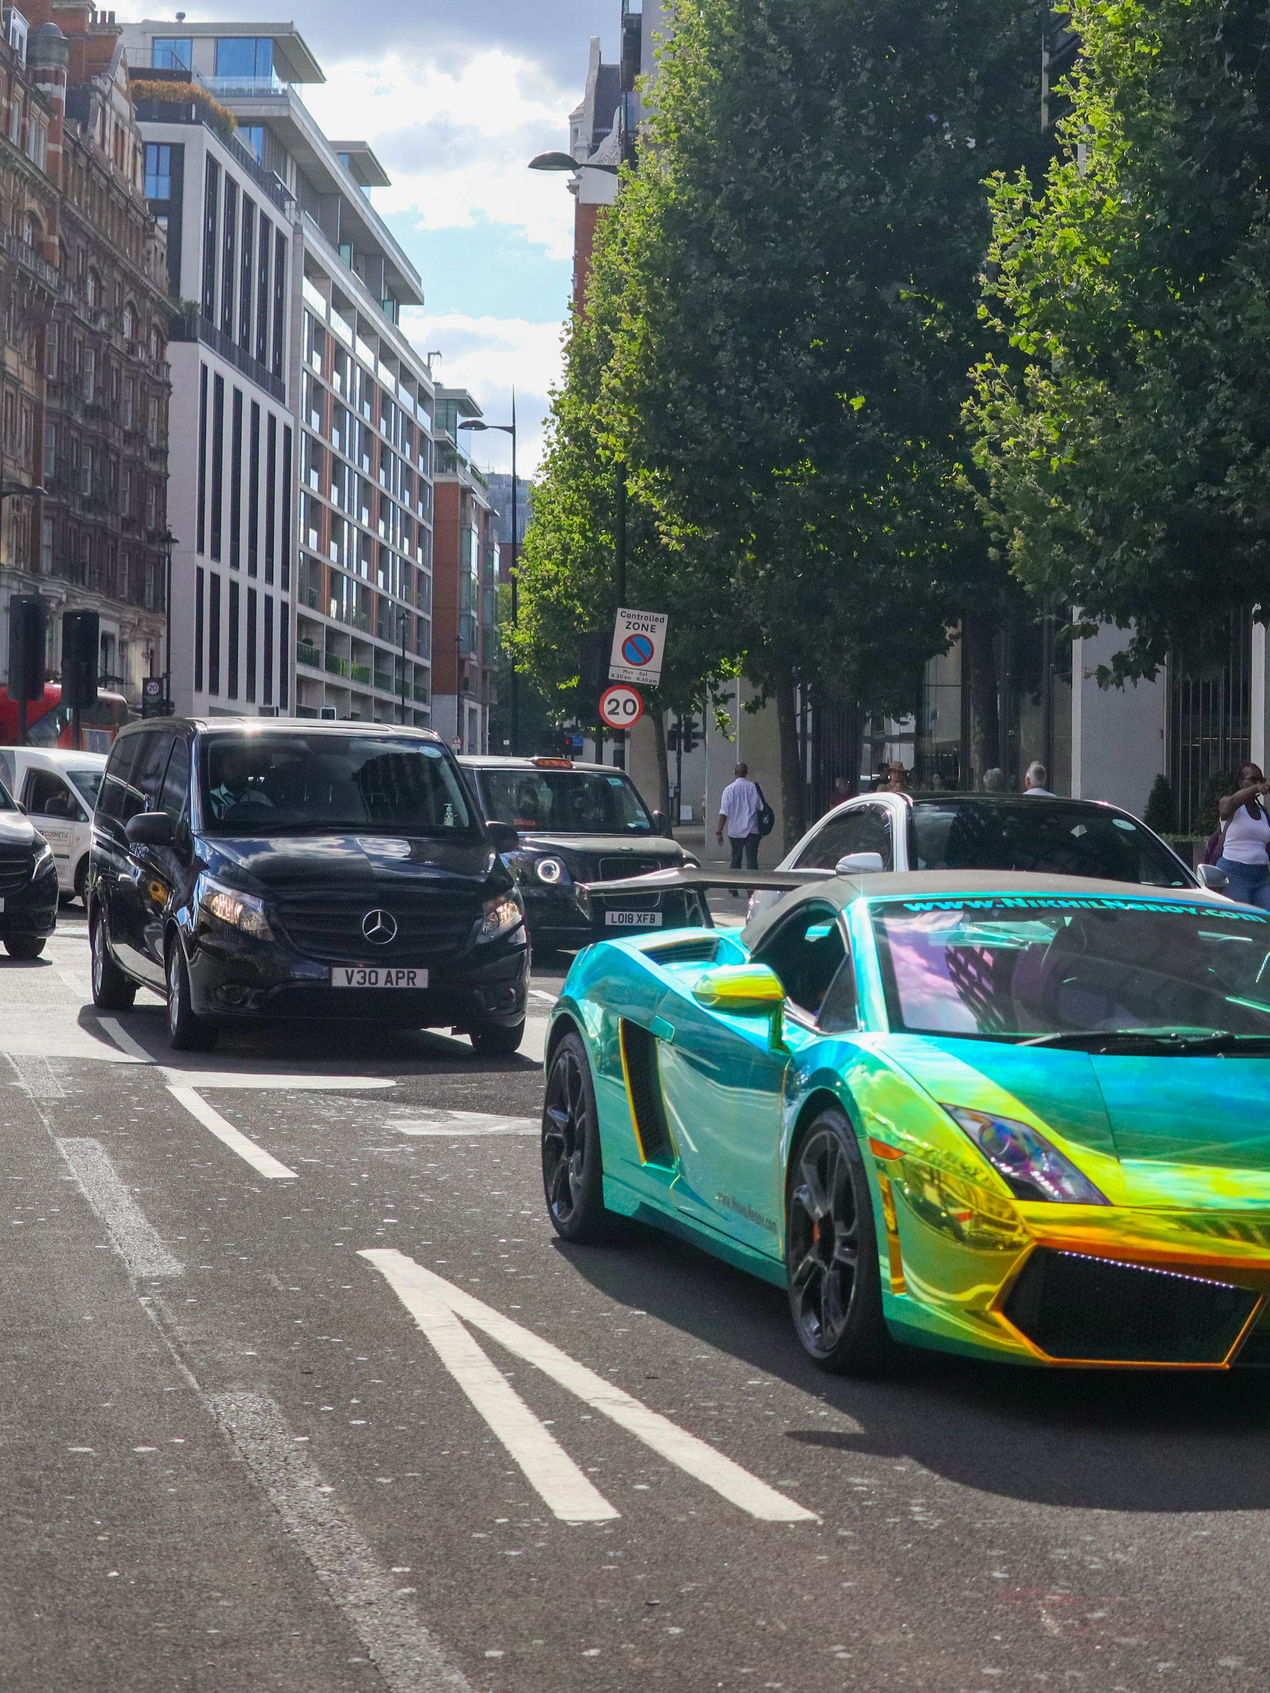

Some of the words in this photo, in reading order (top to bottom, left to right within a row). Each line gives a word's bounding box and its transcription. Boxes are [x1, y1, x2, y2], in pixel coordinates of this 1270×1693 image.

[620, 610, 665, 624] Controlled
[625, 621, 656, 633] ZONE
[148, 684, 157, 692] 20
[607, 698, 637, 716] 20
[636, 913, 656, 924] XFB
[345, 969, 378, 986] V30
[384, 970, 417, 986] APR
